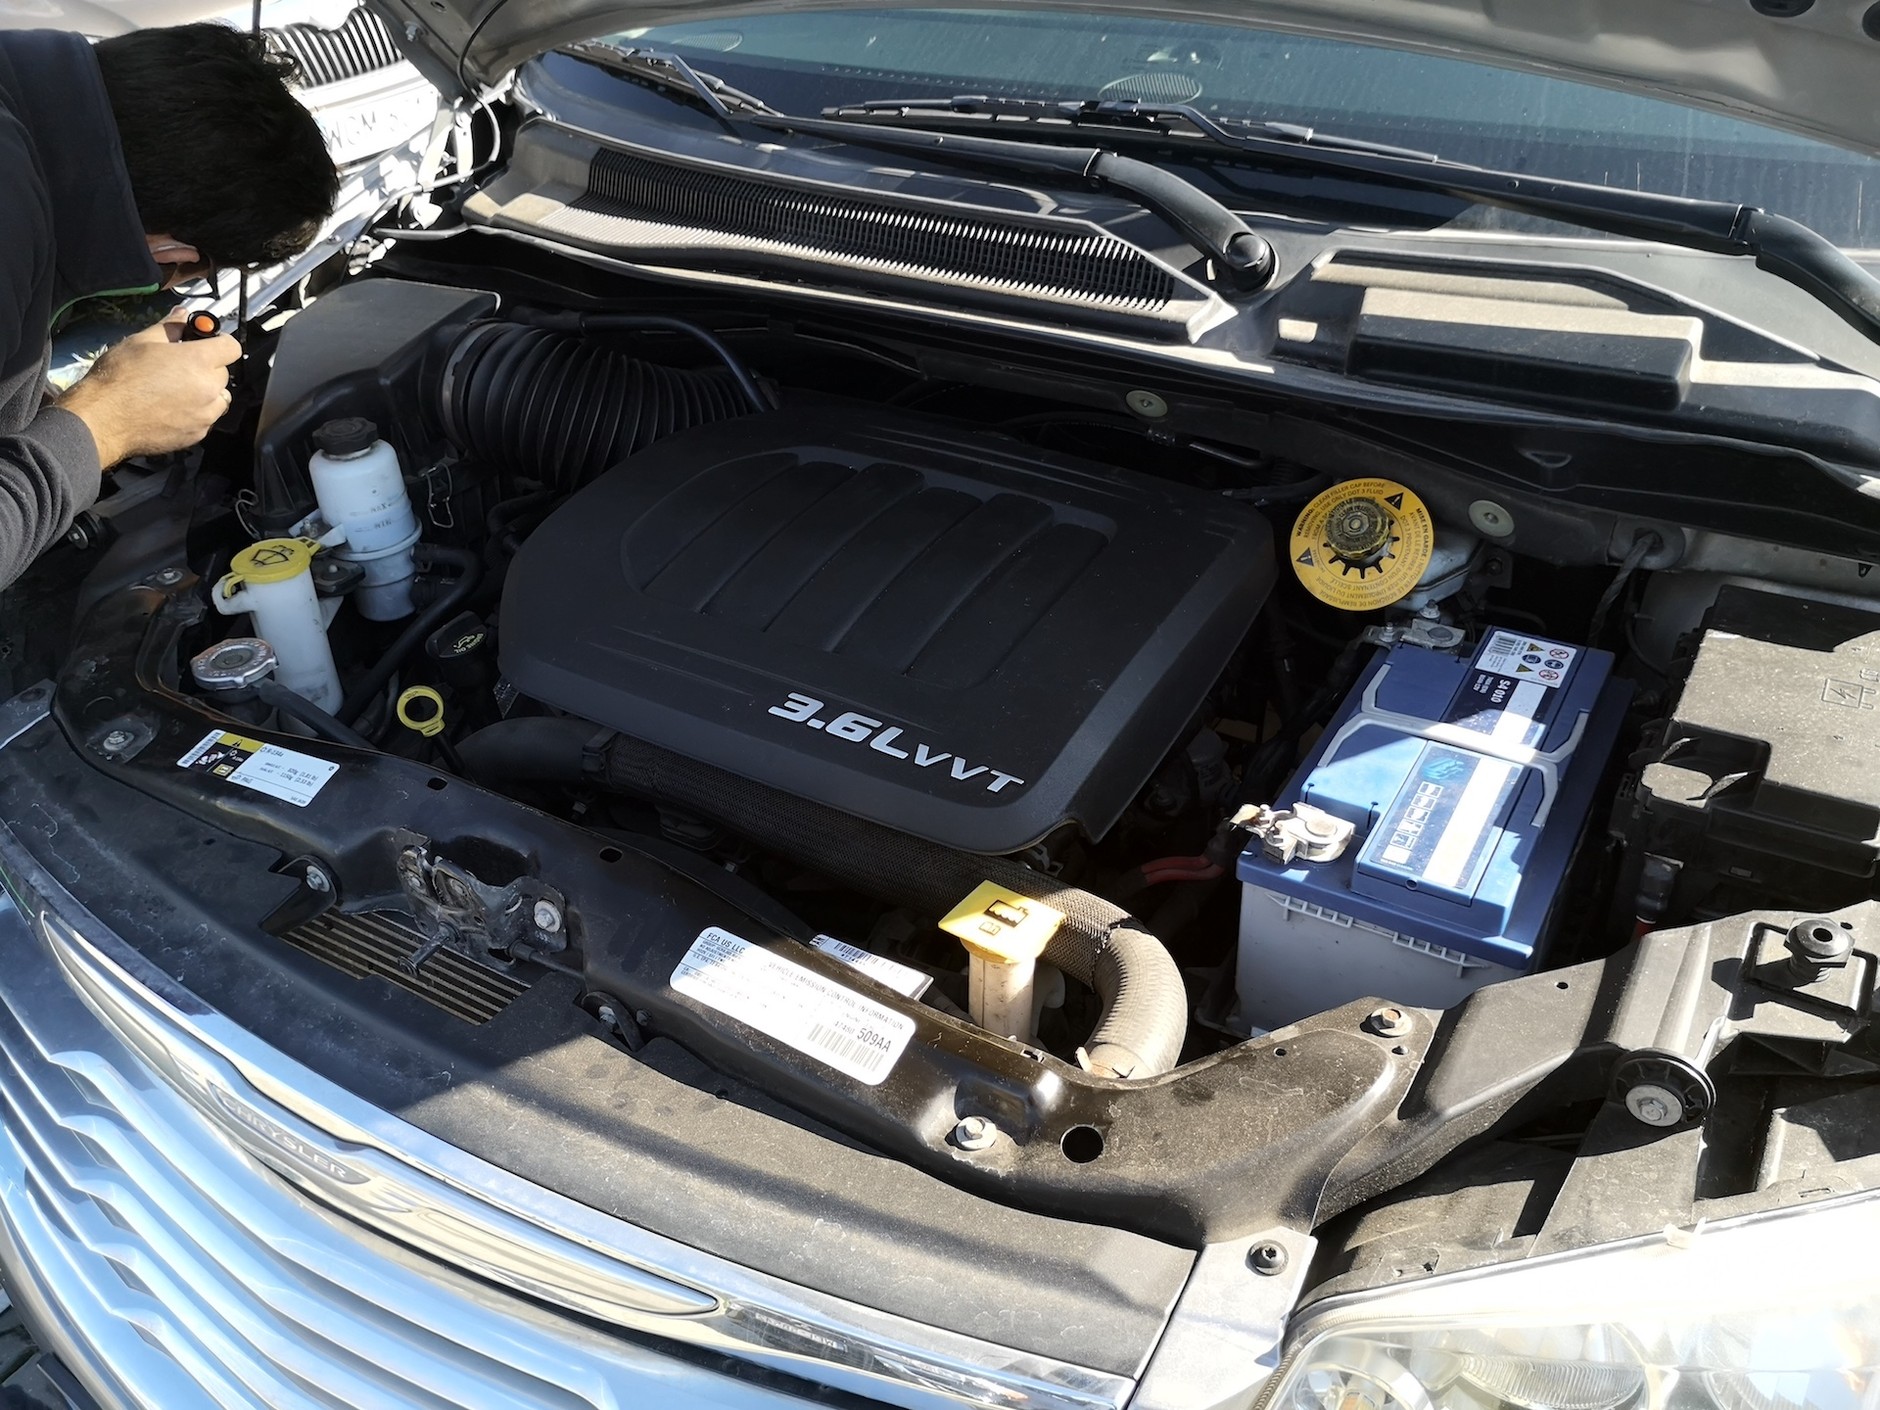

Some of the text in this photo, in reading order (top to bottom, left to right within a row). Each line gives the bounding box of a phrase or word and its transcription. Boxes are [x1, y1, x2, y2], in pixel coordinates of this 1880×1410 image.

[1295, 506, 1314, 536] WARNING:
[1312, 493, 1330, 508] CLEAN
[1329, 484, 1348, 496] FILLER
[1319, 500, 1331, 511] USE
[1330, 492, 1346, 503] ONLY
[1415, 507, 1426, 523] MISE
[1422, 523, 1428, 533] EN
[707, 933, 745, 954] FCA US LLC
[795, 974, 825, 993] EMISSION
[827, 989, 855, 1008] CONTROL
[859, 1005, 903, 1030] INFORMATION
[857, 1028, 891, 1052] 509AA
[222, 1099, 346, 1178] CHRYSLER
